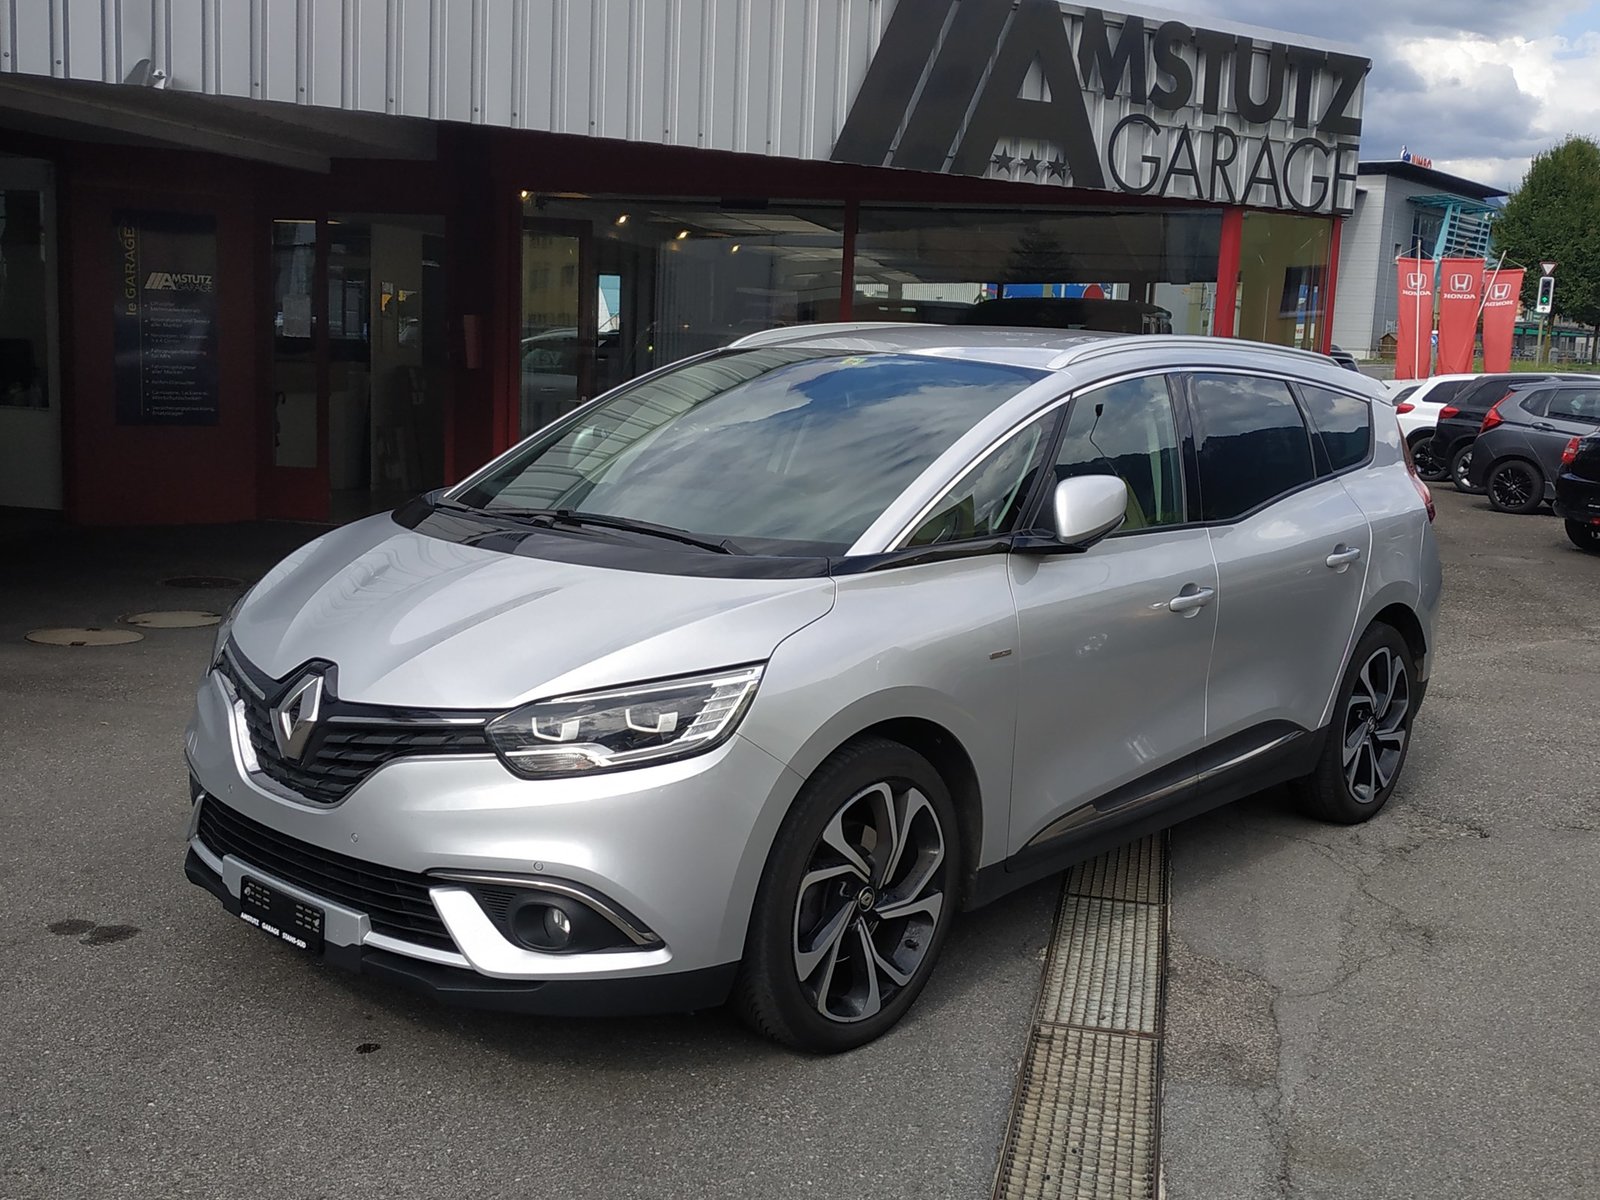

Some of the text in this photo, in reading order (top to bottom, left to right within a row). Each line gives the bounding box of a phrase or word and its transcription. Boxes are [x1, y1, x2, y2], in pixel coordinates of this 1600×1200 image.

[942, 0, 1373, 191] AMSTUTZ
[1108, 113, 1360, 216] GARAGE
[124, 226, 137, 298] GARAGE
[158, 272, 212, 290] AMSTUTZ
[261, 922, 280, 937] GARAGE
